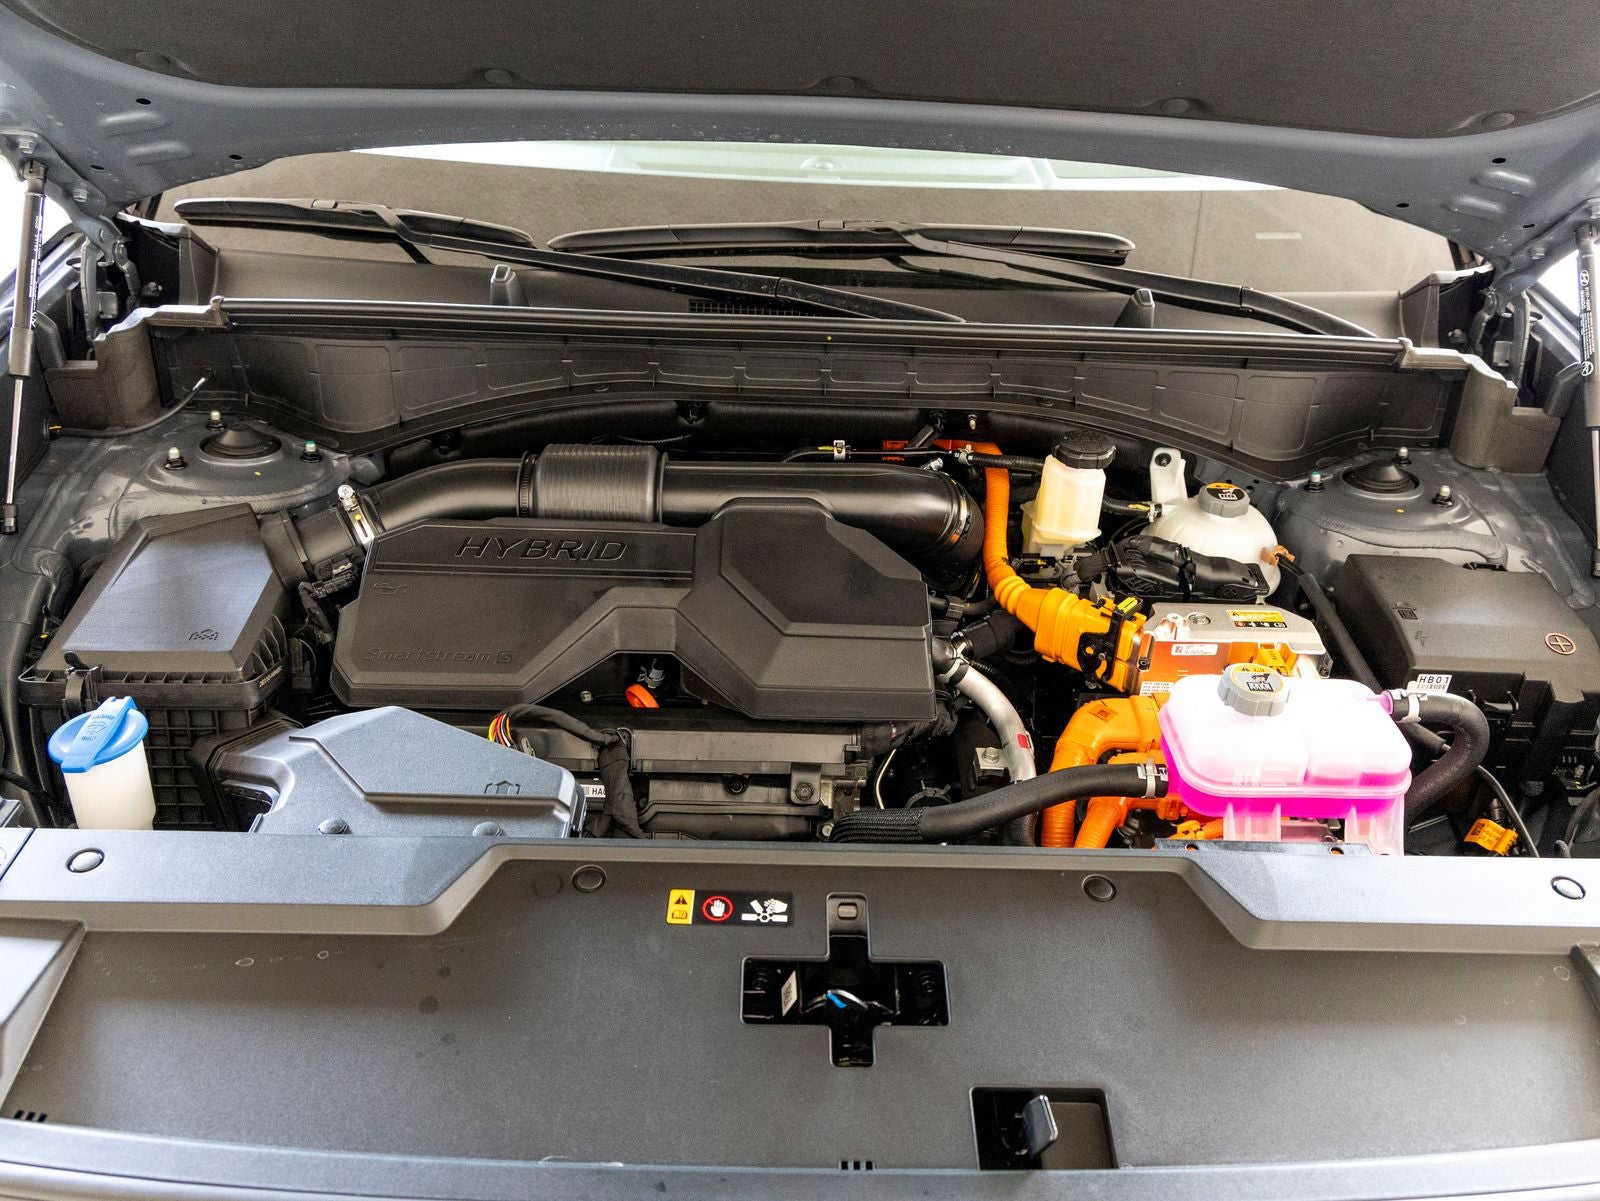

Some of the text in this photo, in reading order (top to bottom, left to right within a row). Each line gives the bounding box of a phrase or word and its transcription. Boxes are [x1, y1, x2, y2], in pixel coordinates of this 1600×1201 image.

[454, 536, 628, 562] HYBRID
[364, 648, 492, 664] Smartstream
[1419, 676, 1449, 684] HB01
